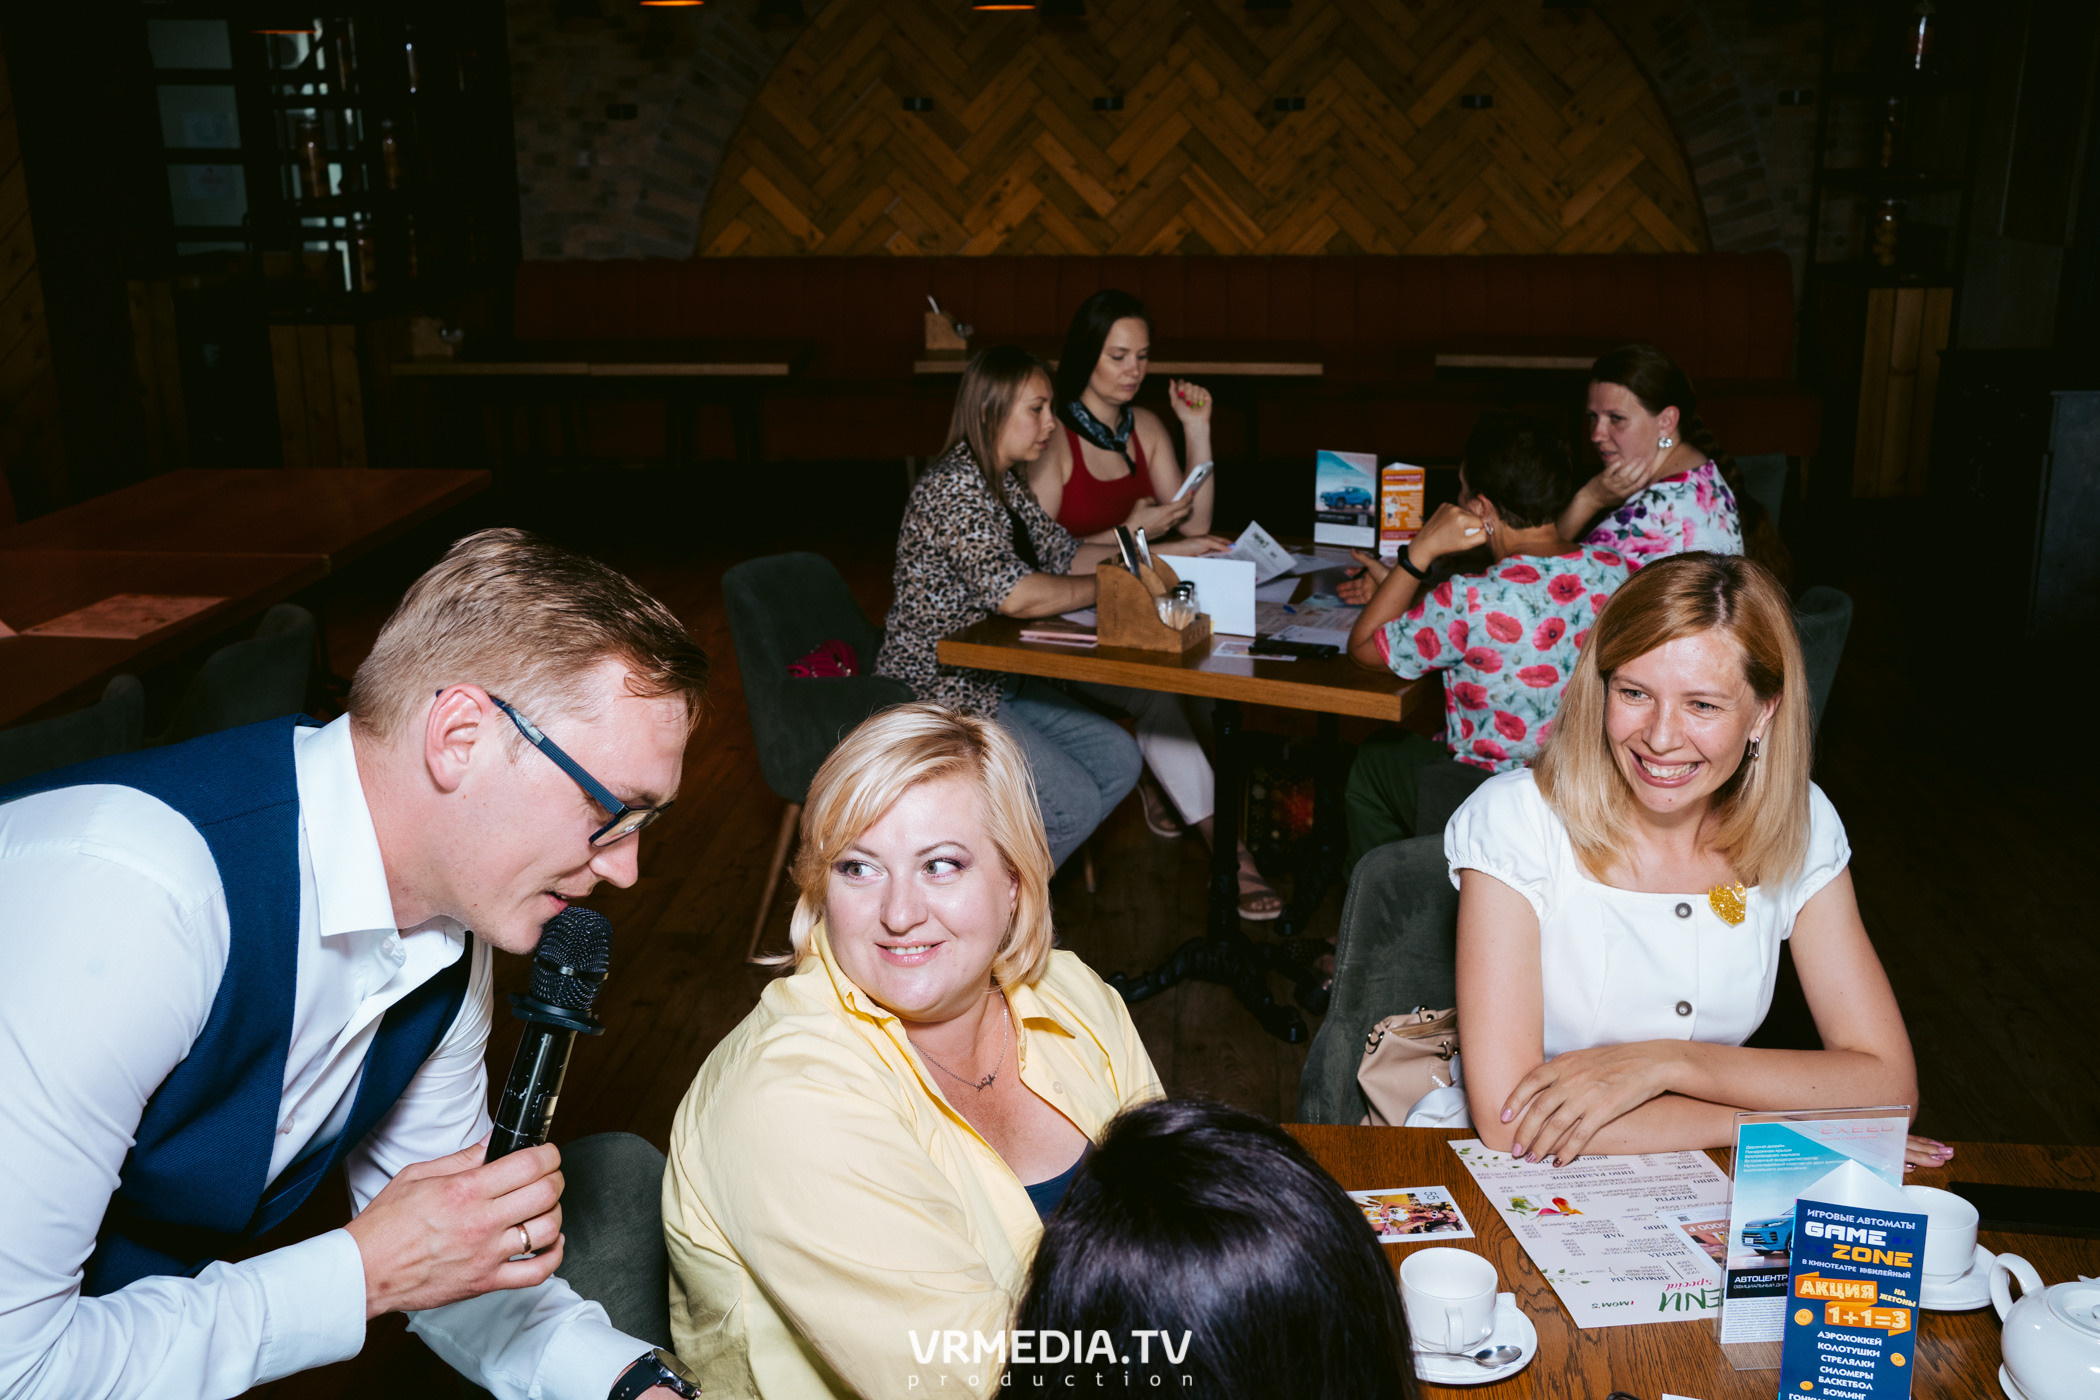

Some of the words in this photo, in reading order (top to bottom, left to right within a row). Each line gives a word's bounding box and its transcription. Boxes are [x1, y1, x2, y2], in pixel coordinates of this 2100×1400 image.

[1807, 1208, 1854, 1222] ИГРОВЫЕ
[1856, 1216, 1916, 1230] АВТОМАТЫ
[1804, 1221, 1887, 1246] GAME
[1832, 1244, 1914, 1268] ZONE
[1808, 1260, 1856, 1272] КИНОТЕАТРЕ
[1860, 1264, 1910, 1278] ЮБИЛЕЙНЫЙ
[1665, 1278, 1712, 1292] special
[1734, 1274, 1788, 1283] АВТОЦЕНТР
[1800, 1280, 1874, 1300] АКЦИЯ
[1894, 1288, 1906, 1296] НА
[1879, 1293, 1916, 1308] ЖЕТОНЫ
[1828, 1306, 1907, 1328] 1+1=3
[1817, 1331, 1882, 1346] АЭРОХОККЕЙ
[1817, 1342, 1880, 1358] КОЛОТУШКИ
[1820, 1354, 1874, 1368] СТРЕЛЯЛКИ
[1820, 1366, 1874, 1380] СИЛОМЕРЫ
[1818, 1376, 1873, 1390] БАСКЕТБОЛ
[1823, 1388, 1866, 1400] БОУЛИНГ
